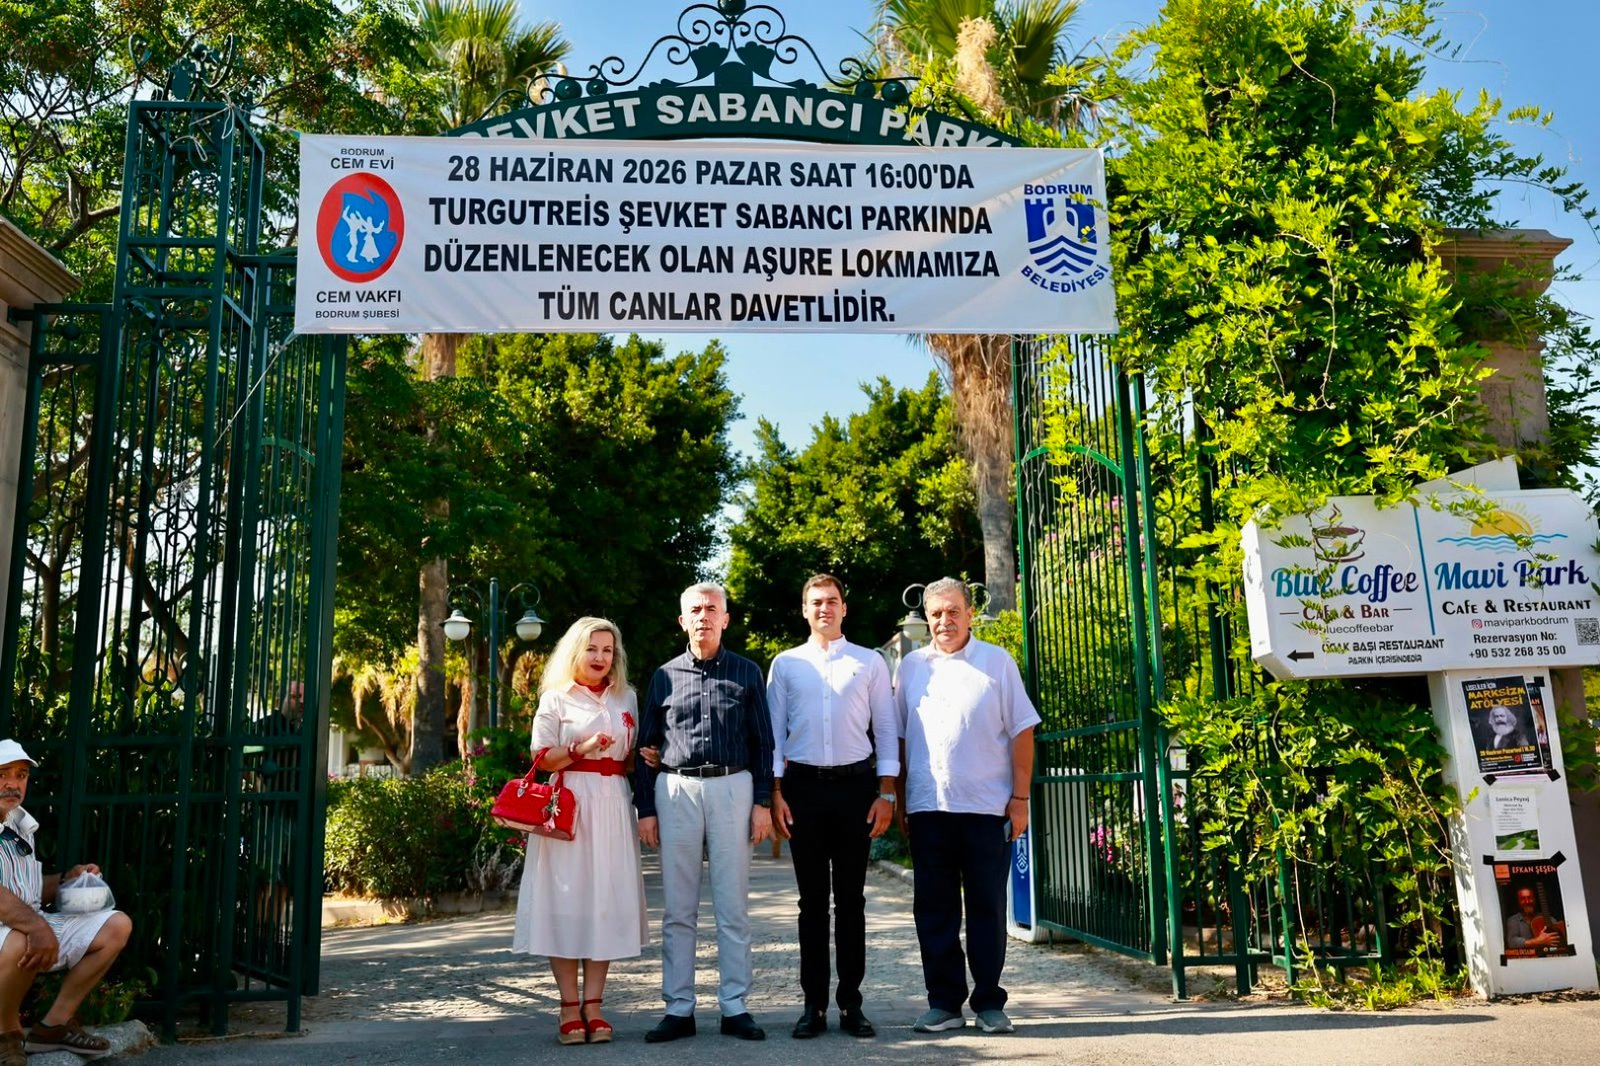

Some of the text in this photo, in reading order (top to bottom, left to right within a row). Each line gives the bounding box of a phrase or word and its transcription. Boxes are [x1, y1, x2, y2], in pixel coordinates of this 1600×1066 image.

[460, 93, 1012, 147] VKET SABANCI PARK
[340, 148, 385, 156] BODRUM
[330, 156, 394, 170] CEM EVİ
[448, 152, 974, 189] 28 HAZİRAN 2026 PAZAR SAAT 16:00'DA
[1024, 184, 1093, 195] BODRUM
[428, 194, 993, 234] TURGUTREİS ŞEVKET SABANCI PARKINDA
[424, 238, 1000, 282] DÜZENLENECEK OLAN AŞURE LOKMAMIZA
[1021, 264, 1109, 293] BELEDİYESİ
[316, 290, 401, 303] CEM VAKFI
[538, 285, 895, 322] TÜM CANLAR DAVETLİDİR.
[315, 309, 400, 319] BODRUM ŞUBESİ
[1434, 559, 1589, 590] Mavi Park
[1341, 564, 1419, 603] Coffee
[1343, 604, 1355, 619] &
[1485, 600, 1498, 613] &
[1321, 623, 1394, 634] luecoffeebar
[1484, 616, 1569, 628] maviparkbodrum
[1473, 632, 1557, 643] Rezervasyon No:
[1353, 641, 1377, 654] BAŞI
[1379, 639, 1445, 650] RESTAURANT
[1469, 645, 1566, 658] +90 532 268 35 00
[1348, 656, 1373, 665] PARKIN
[1468, 686, 1526, 699] MARKSİZM
[1470, 695, 1523, 709] ATÖLYESİ
